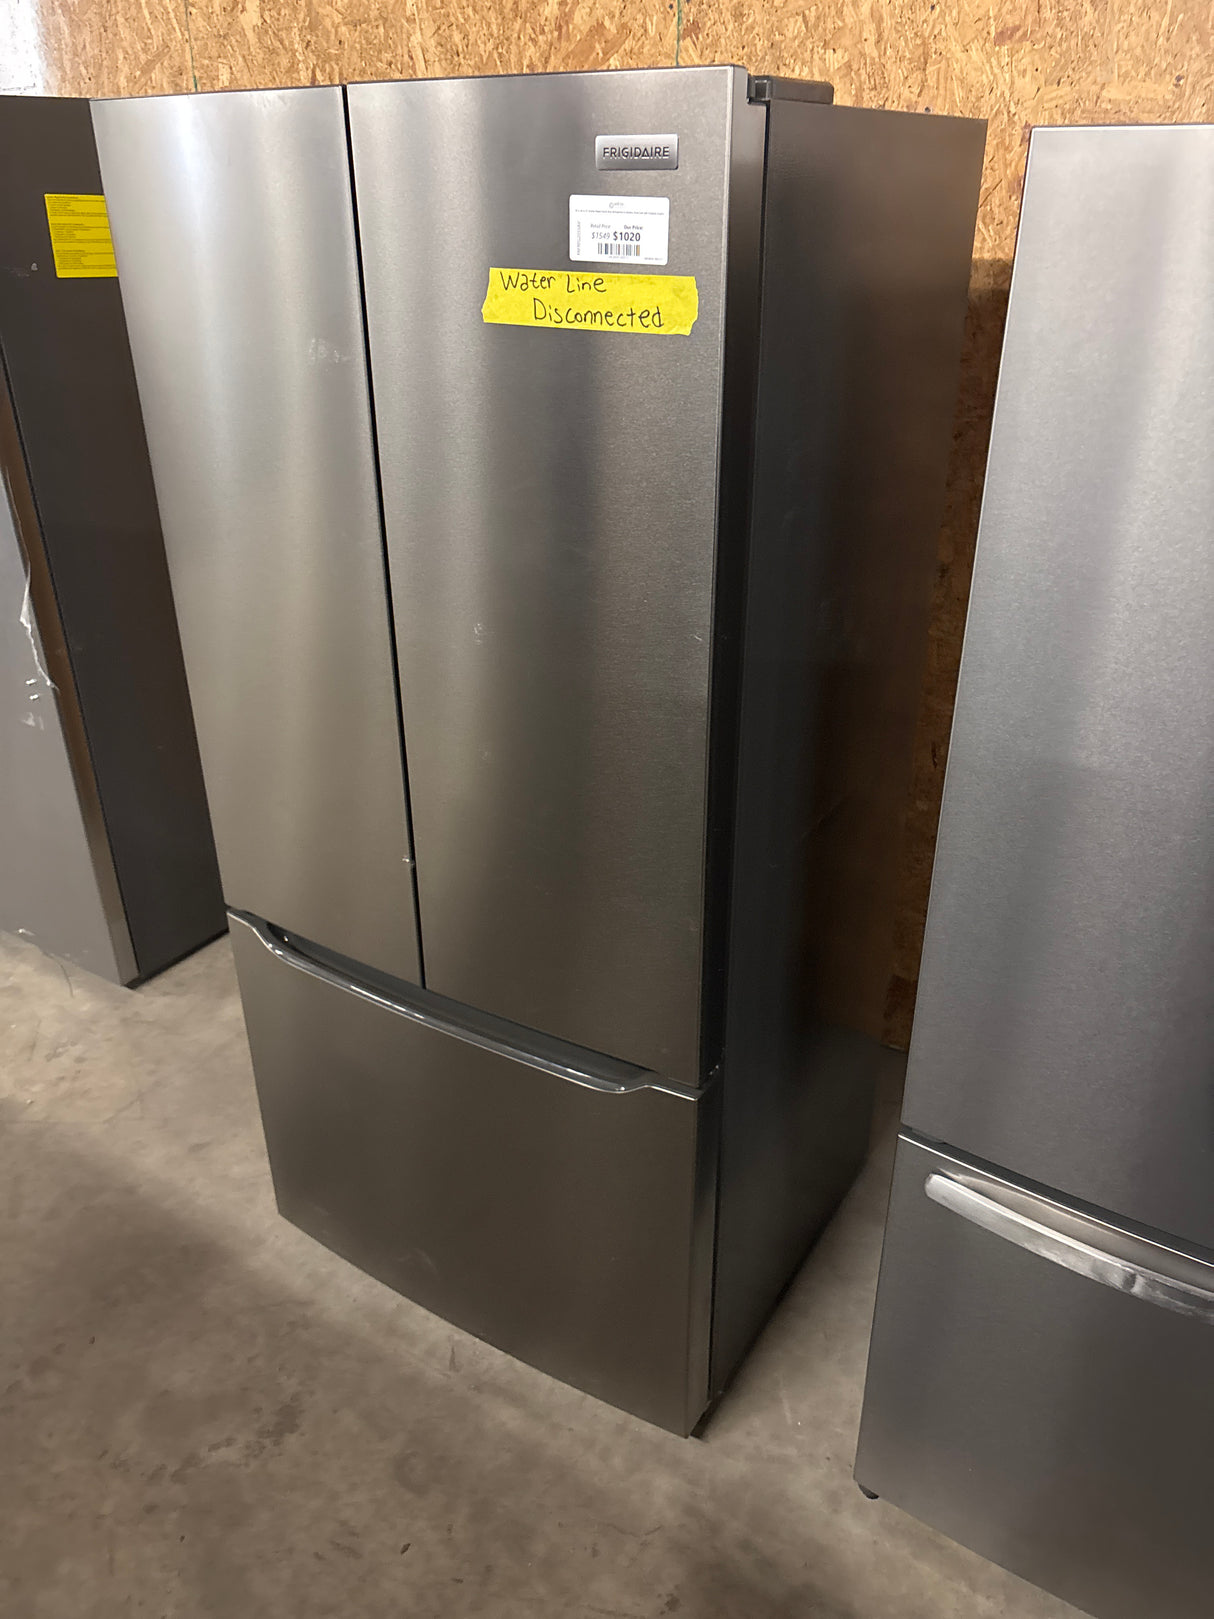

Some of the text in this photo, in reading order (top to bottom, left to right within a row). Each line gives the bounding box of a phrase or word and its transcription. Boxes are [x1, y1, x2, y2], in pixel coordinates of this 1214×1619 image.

[603, 146, 669, 158] FRIGIDAIRE
[591, 231, 610, 240] $1549
[613, 231, 641, 242] $1020
[500, 272, 607, 293] Water Line
[533, 298, 664, 328] Disconnected
